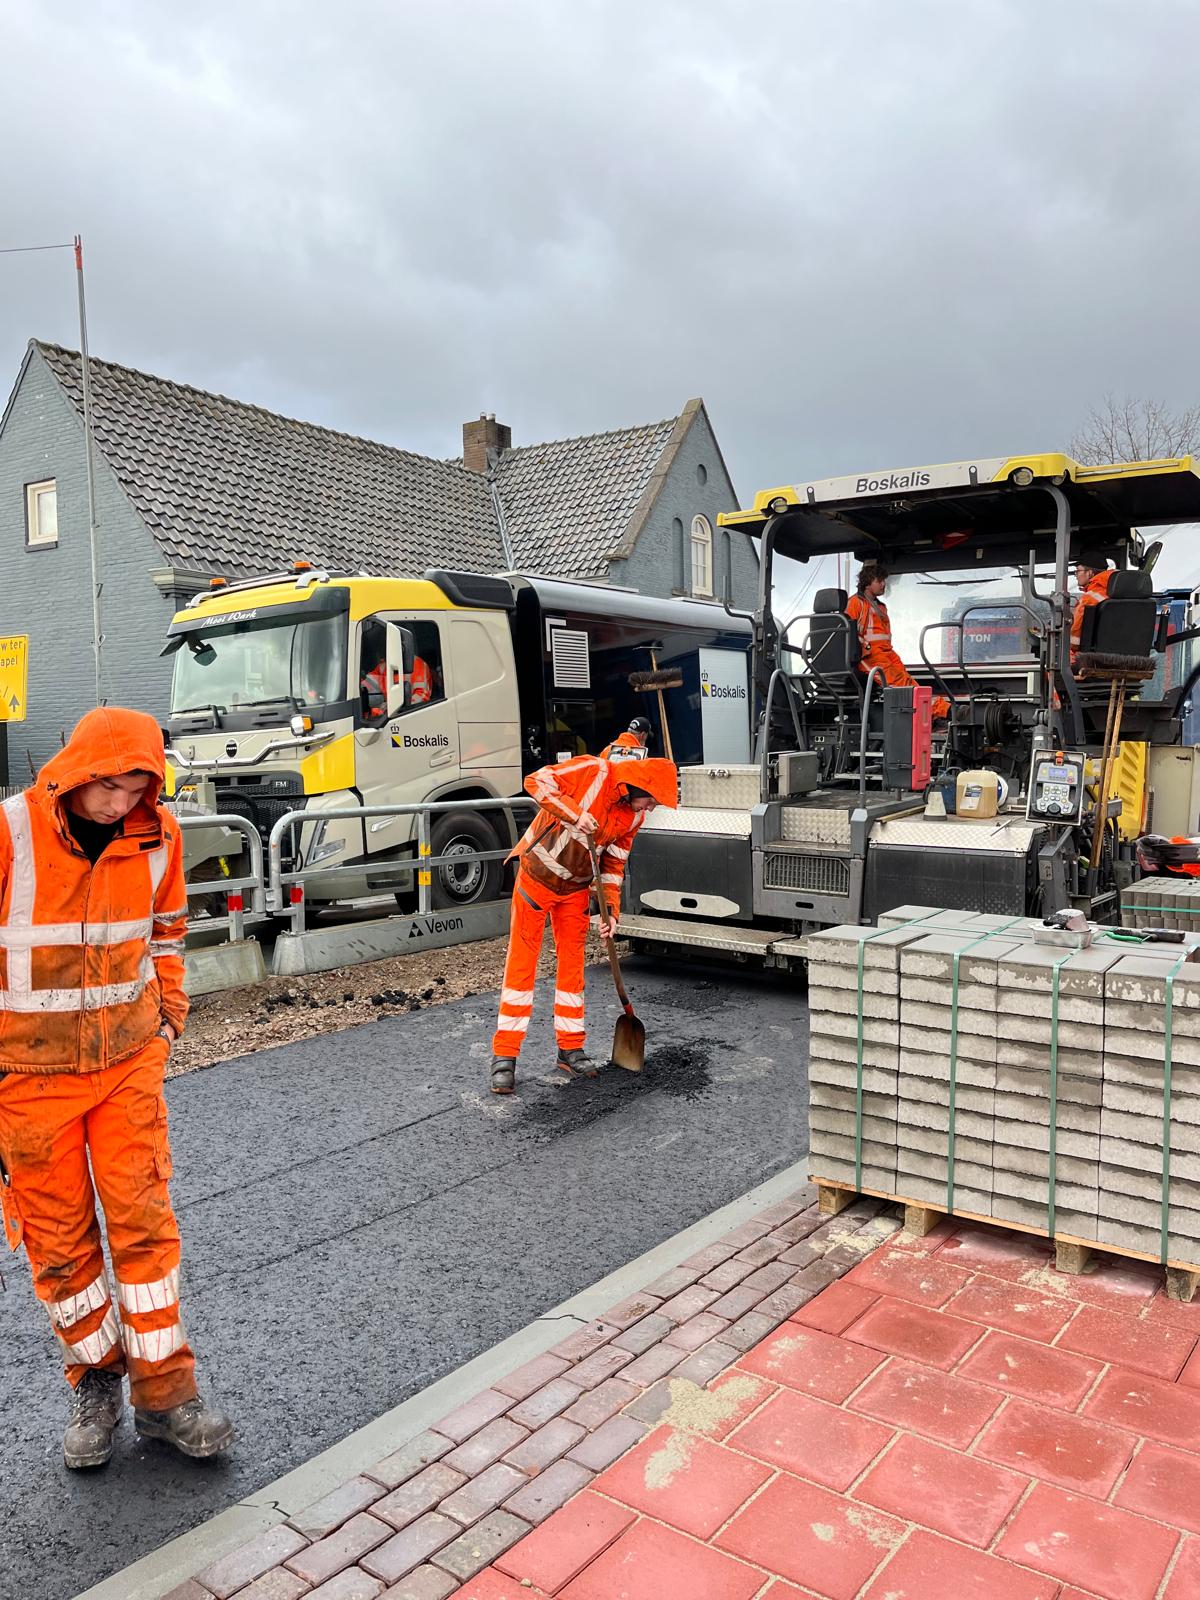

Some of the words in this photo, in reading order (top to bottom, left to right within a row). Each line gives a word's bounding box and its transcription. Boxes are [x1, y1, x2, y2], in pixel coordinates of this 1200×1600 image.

[856, 472, 930, 493] Boskalis
[10, 640, 22, 650] ter
[711, 684, 746, 698] Boskalis
[404, 734, 449, 747] Boskalis
[425, 917, 463, 934] Vevon
